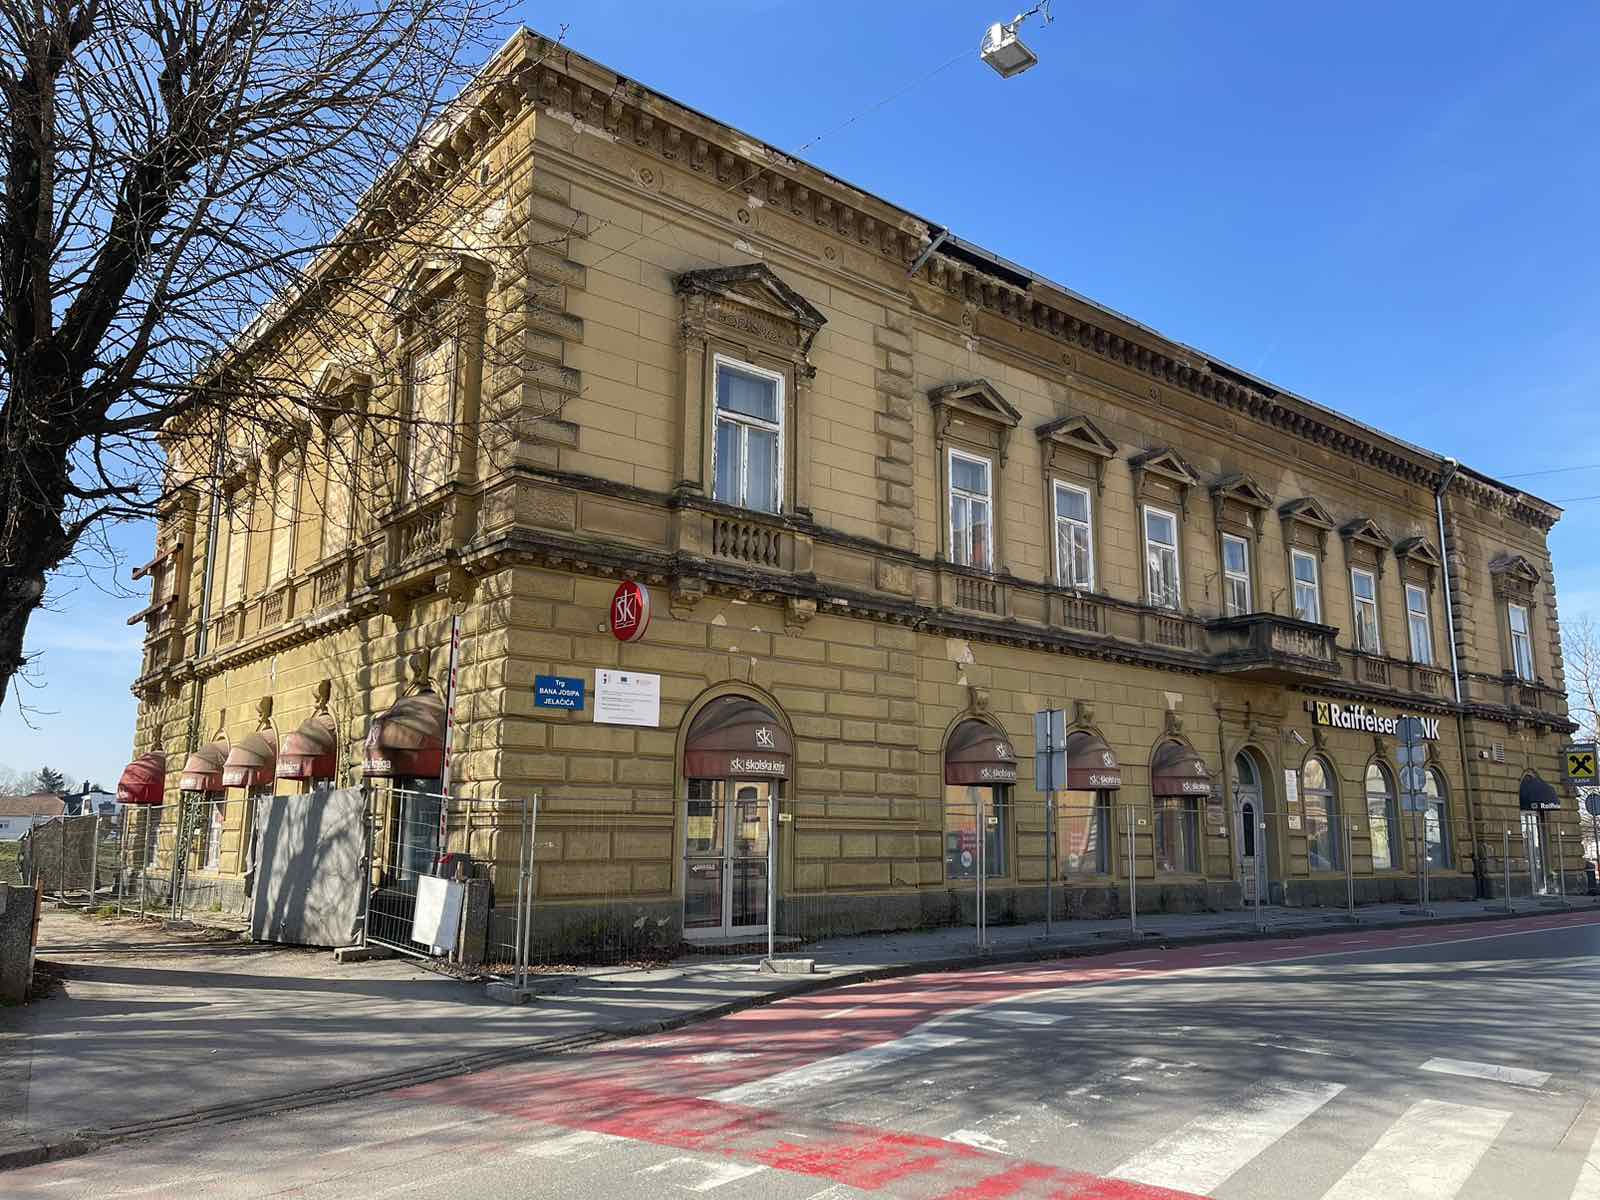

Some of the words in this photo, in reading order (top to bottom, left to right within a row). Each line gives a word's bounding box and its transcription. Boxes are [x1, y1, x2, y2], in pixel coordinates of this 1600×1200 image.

[555, 679, 566, 688] Trg
[539, 687, 557, 695] BANA
[558, 688, 580, 697] JOSIPA
